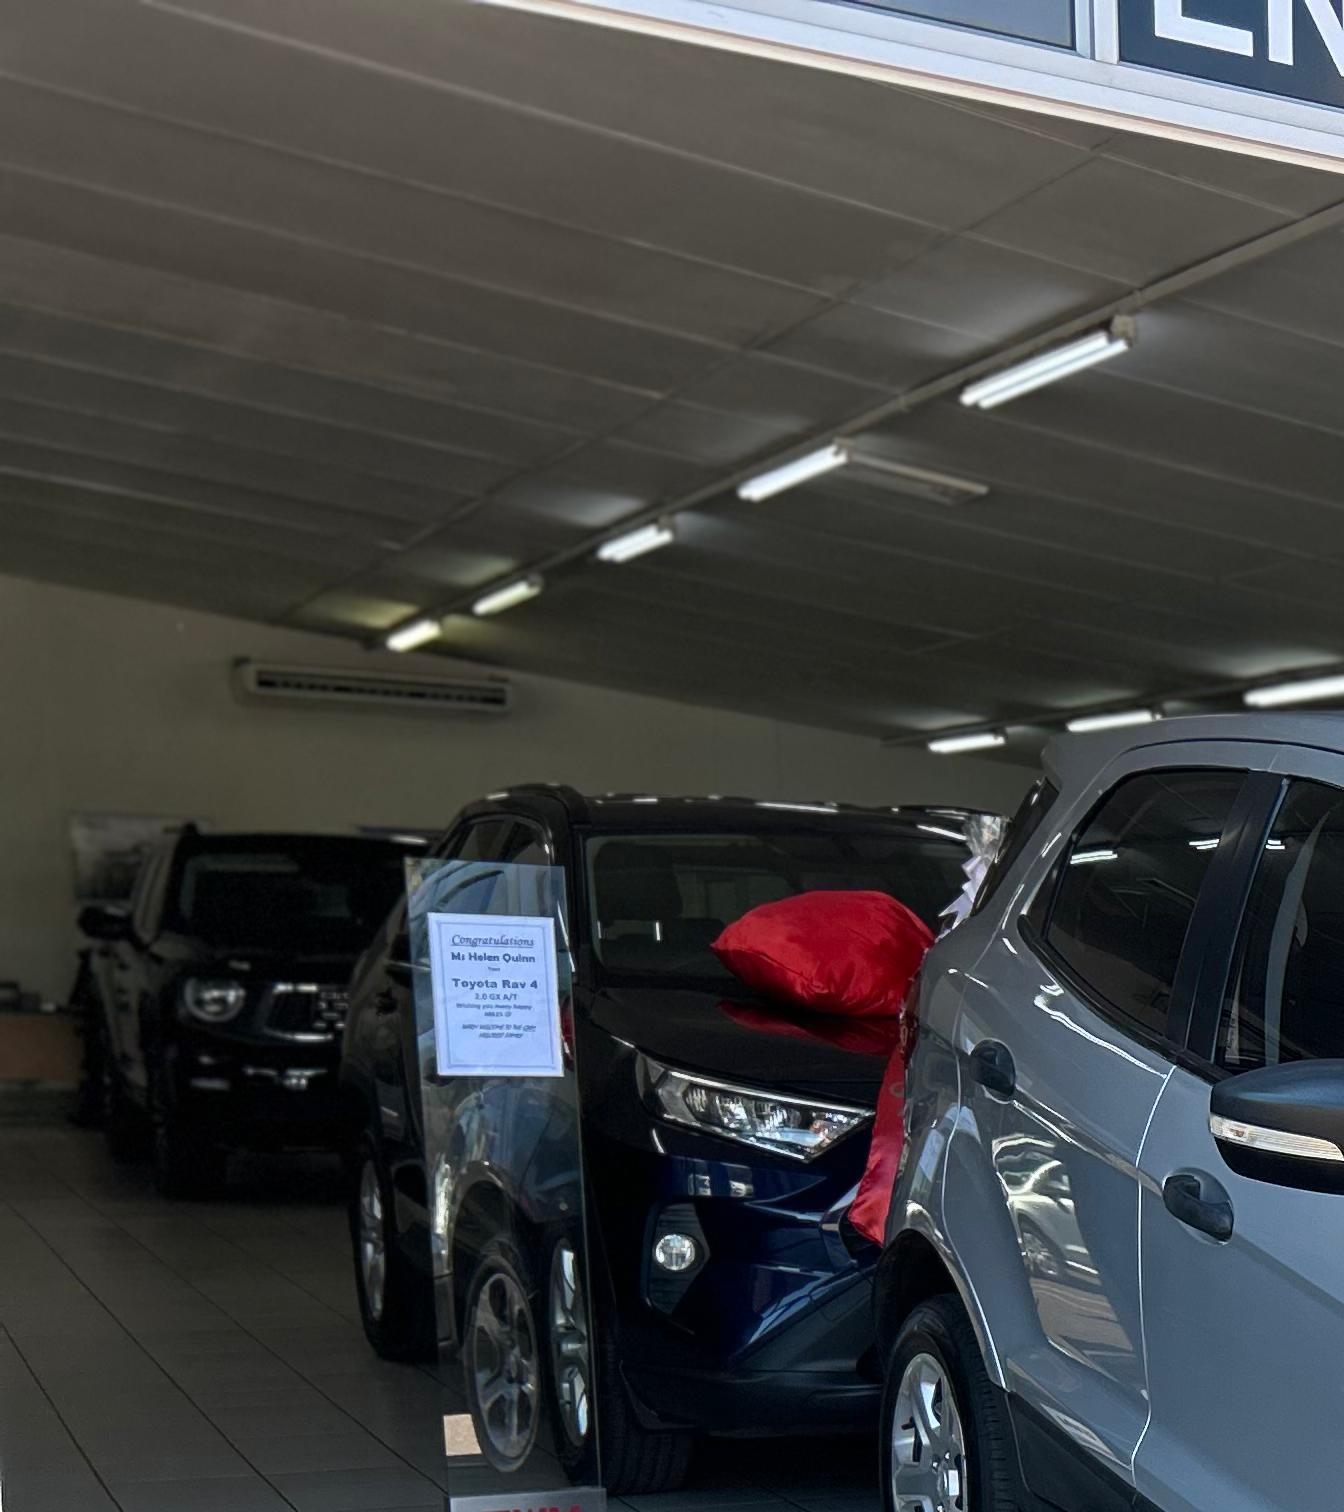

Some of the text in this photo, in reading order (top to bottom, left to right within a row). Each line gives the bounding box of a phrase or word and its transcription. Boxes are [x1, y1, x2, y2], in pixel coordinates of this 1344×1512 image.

[450, 934, 535, 948] Congratulations
[468, 952, 500, 962] Helen
[502, 953, 536, 964] Quinn
[451, 978, 538, 990] Toyota Rav 4
